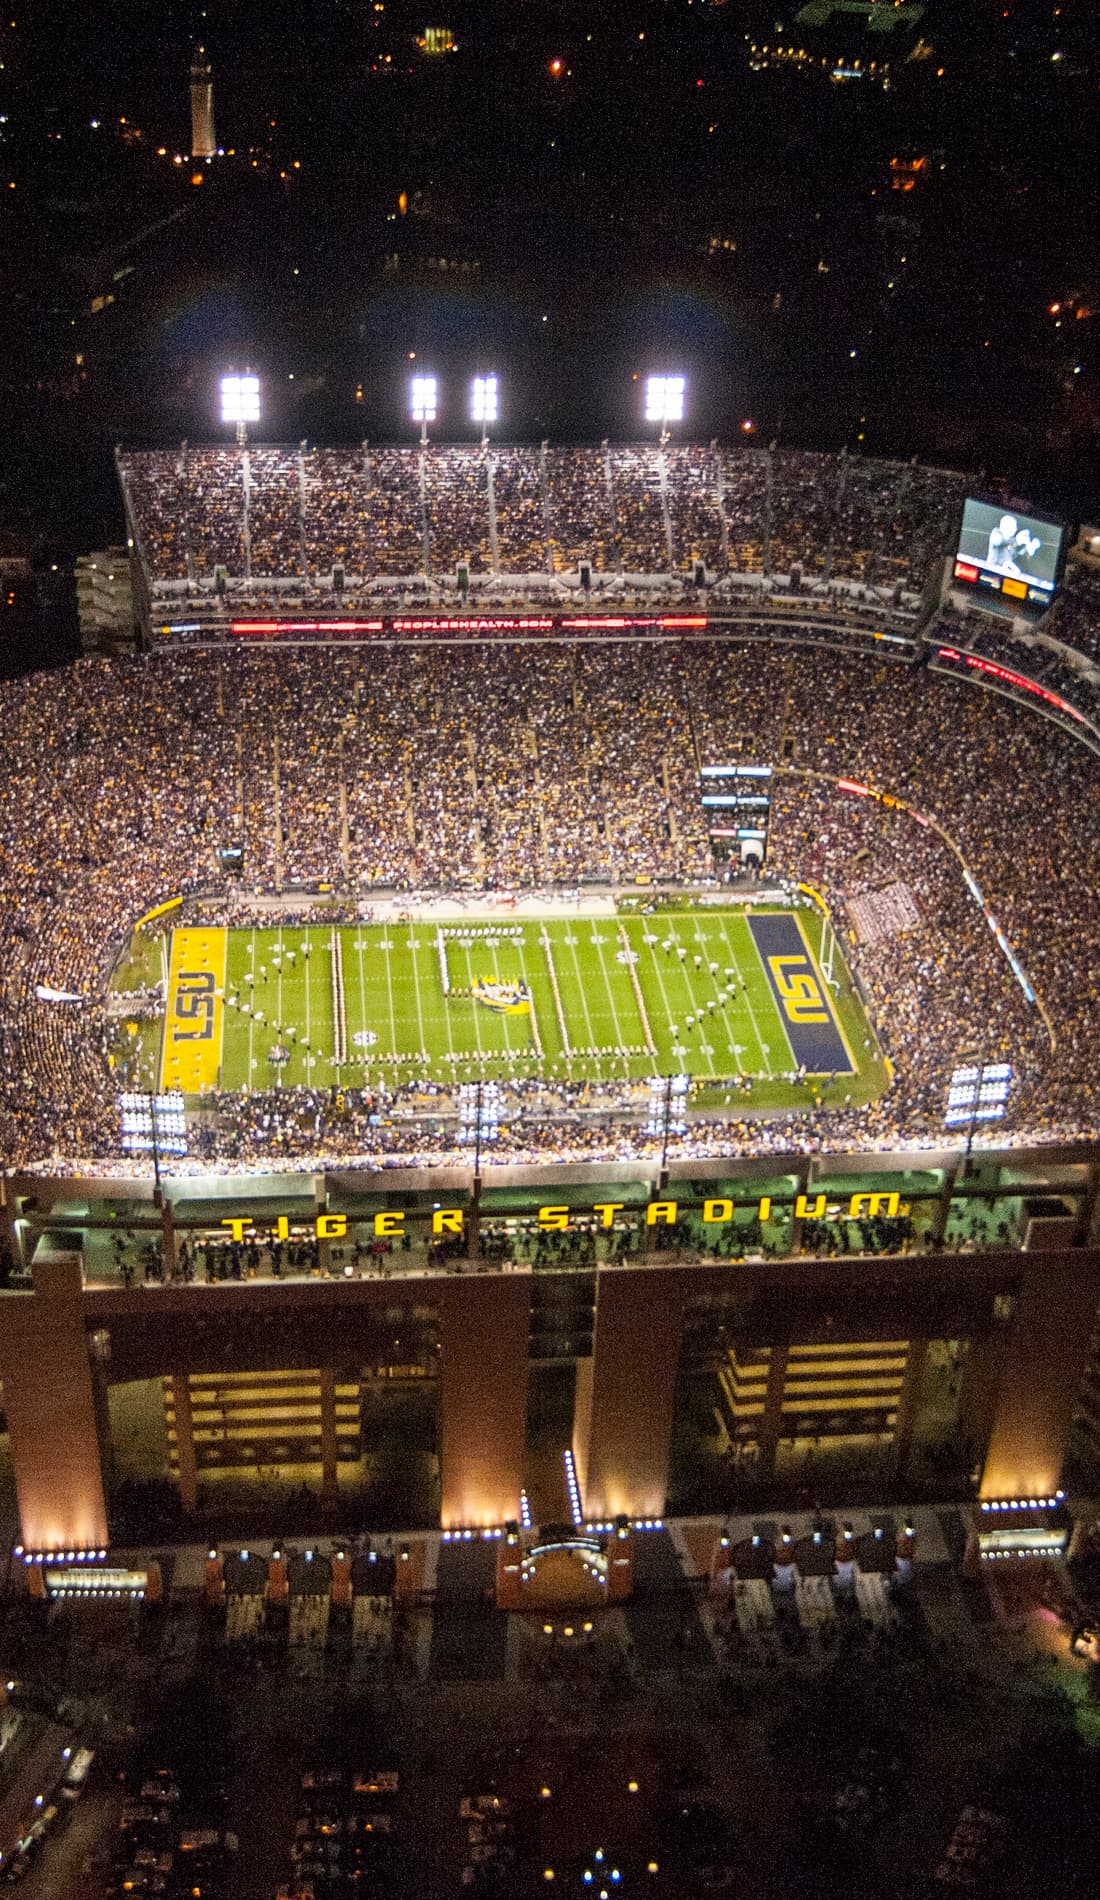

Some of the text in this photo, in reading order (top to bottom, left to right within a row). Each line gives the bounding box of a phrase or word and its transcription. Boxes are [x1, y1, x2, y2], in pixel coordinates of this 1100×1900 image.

[173, 971, 216, 1041] LSU
[767, 954, 830, 1023] LSU
[221, 1191, 900, 1242] TIGER STADIUM
